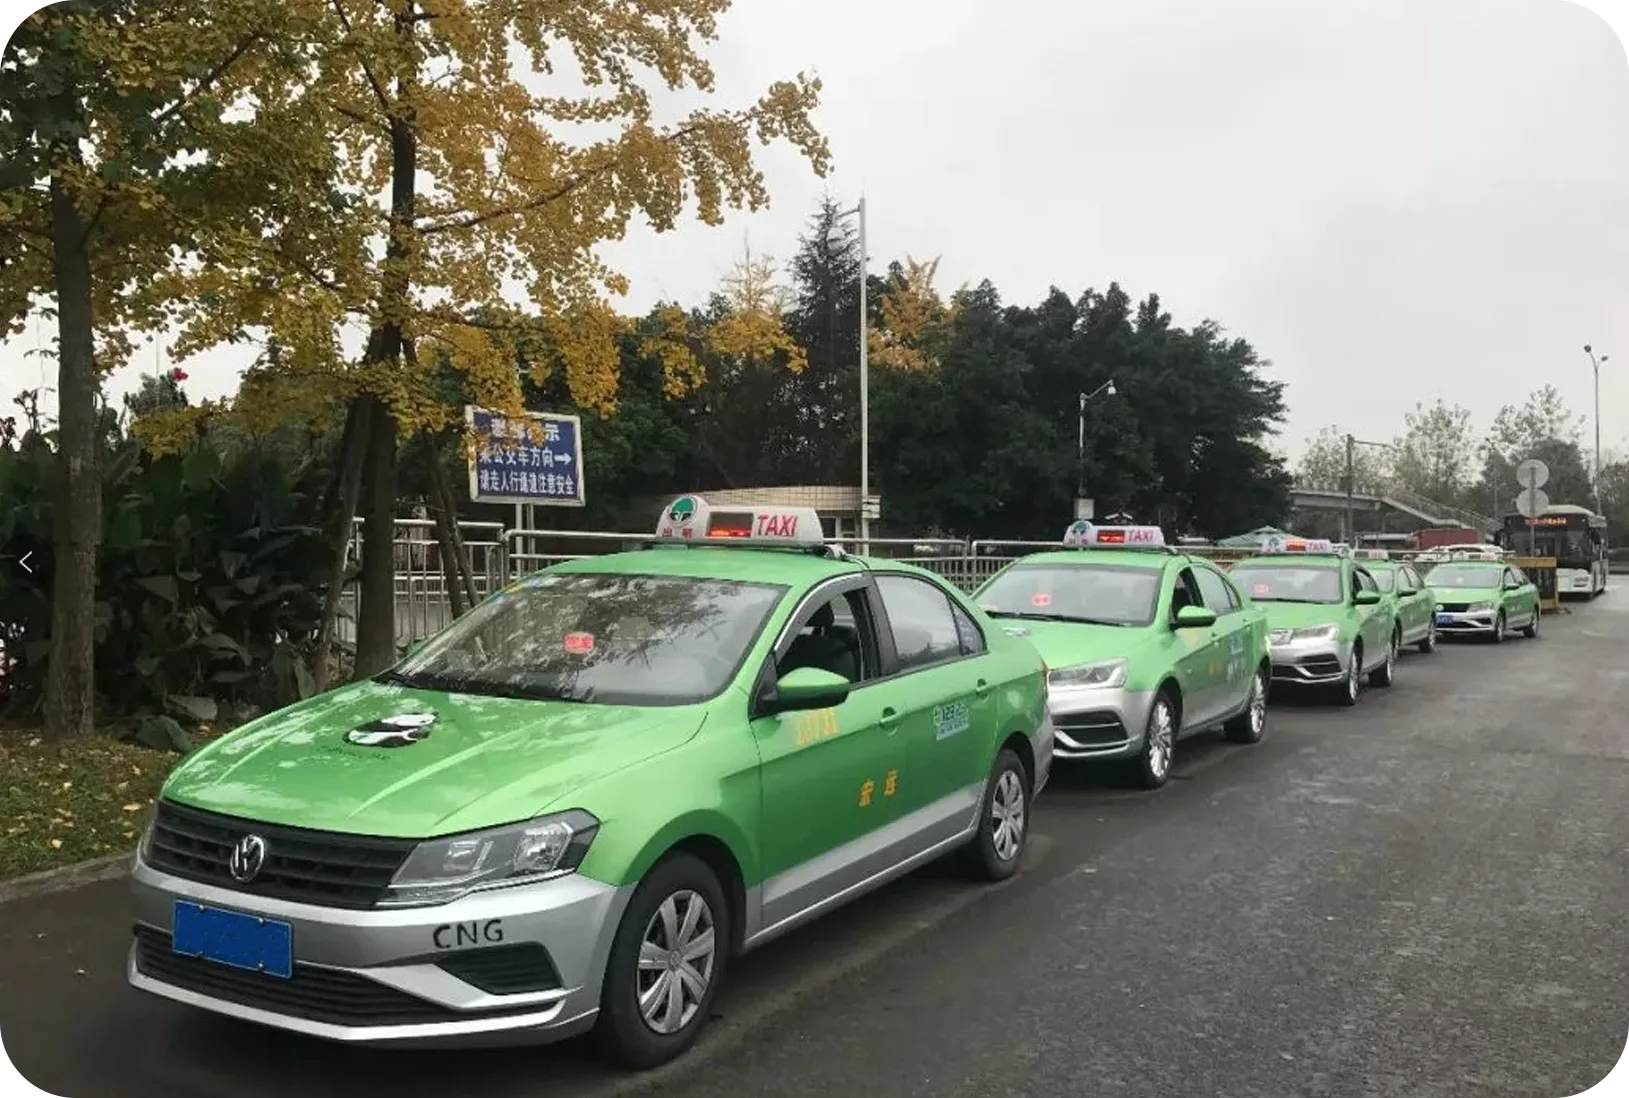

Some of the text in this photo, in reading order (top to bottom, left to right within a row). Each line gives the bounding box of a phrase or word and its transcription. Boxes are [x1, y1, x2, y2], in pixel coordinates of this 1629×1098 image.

[758, 514, 799, 537] TAXI
[1128, 530, 1154, 541] TAXI
[433, 919, 503, 949] CNG
